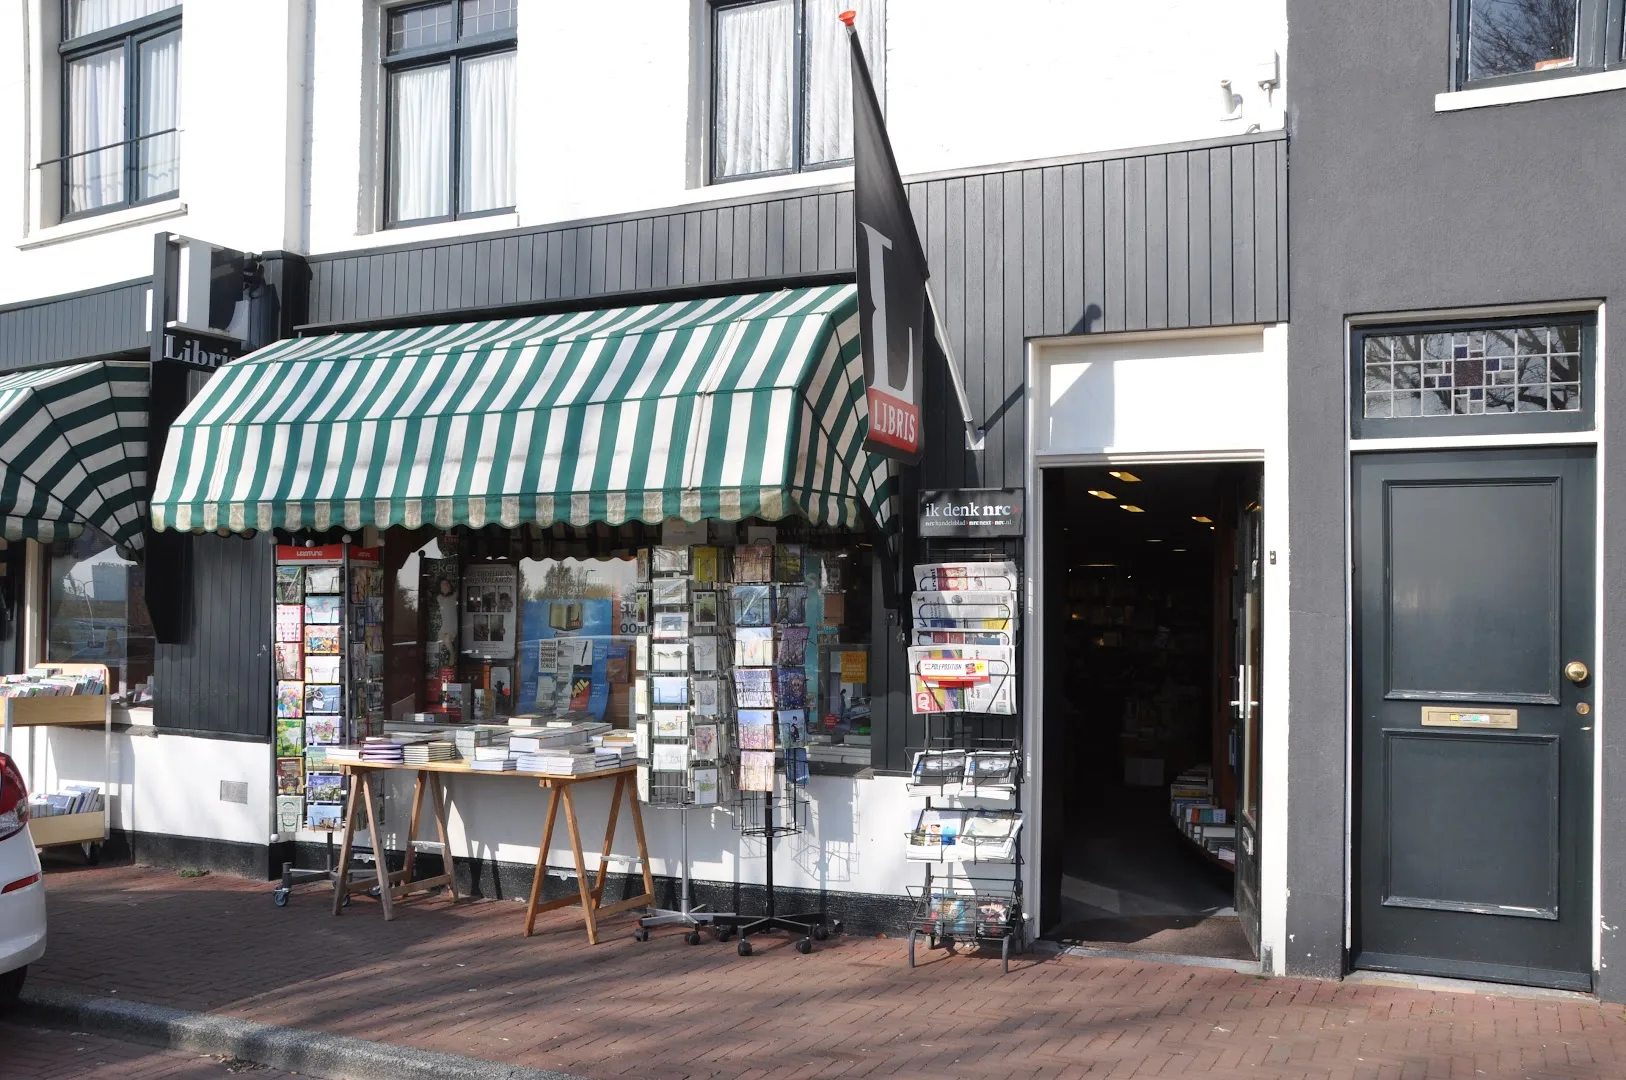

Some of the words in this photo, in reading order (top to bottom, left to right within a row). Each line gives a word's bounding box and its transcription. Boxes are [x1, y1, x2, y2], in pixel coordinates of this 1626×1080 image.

[873, 398, 916, 444] LIBRIS
[925, 503, 940, 517] ik
[943, 502, 980, 517] denk
[983, 504, 1011, 517] nrc
[917, 693, 930, 711] AD
